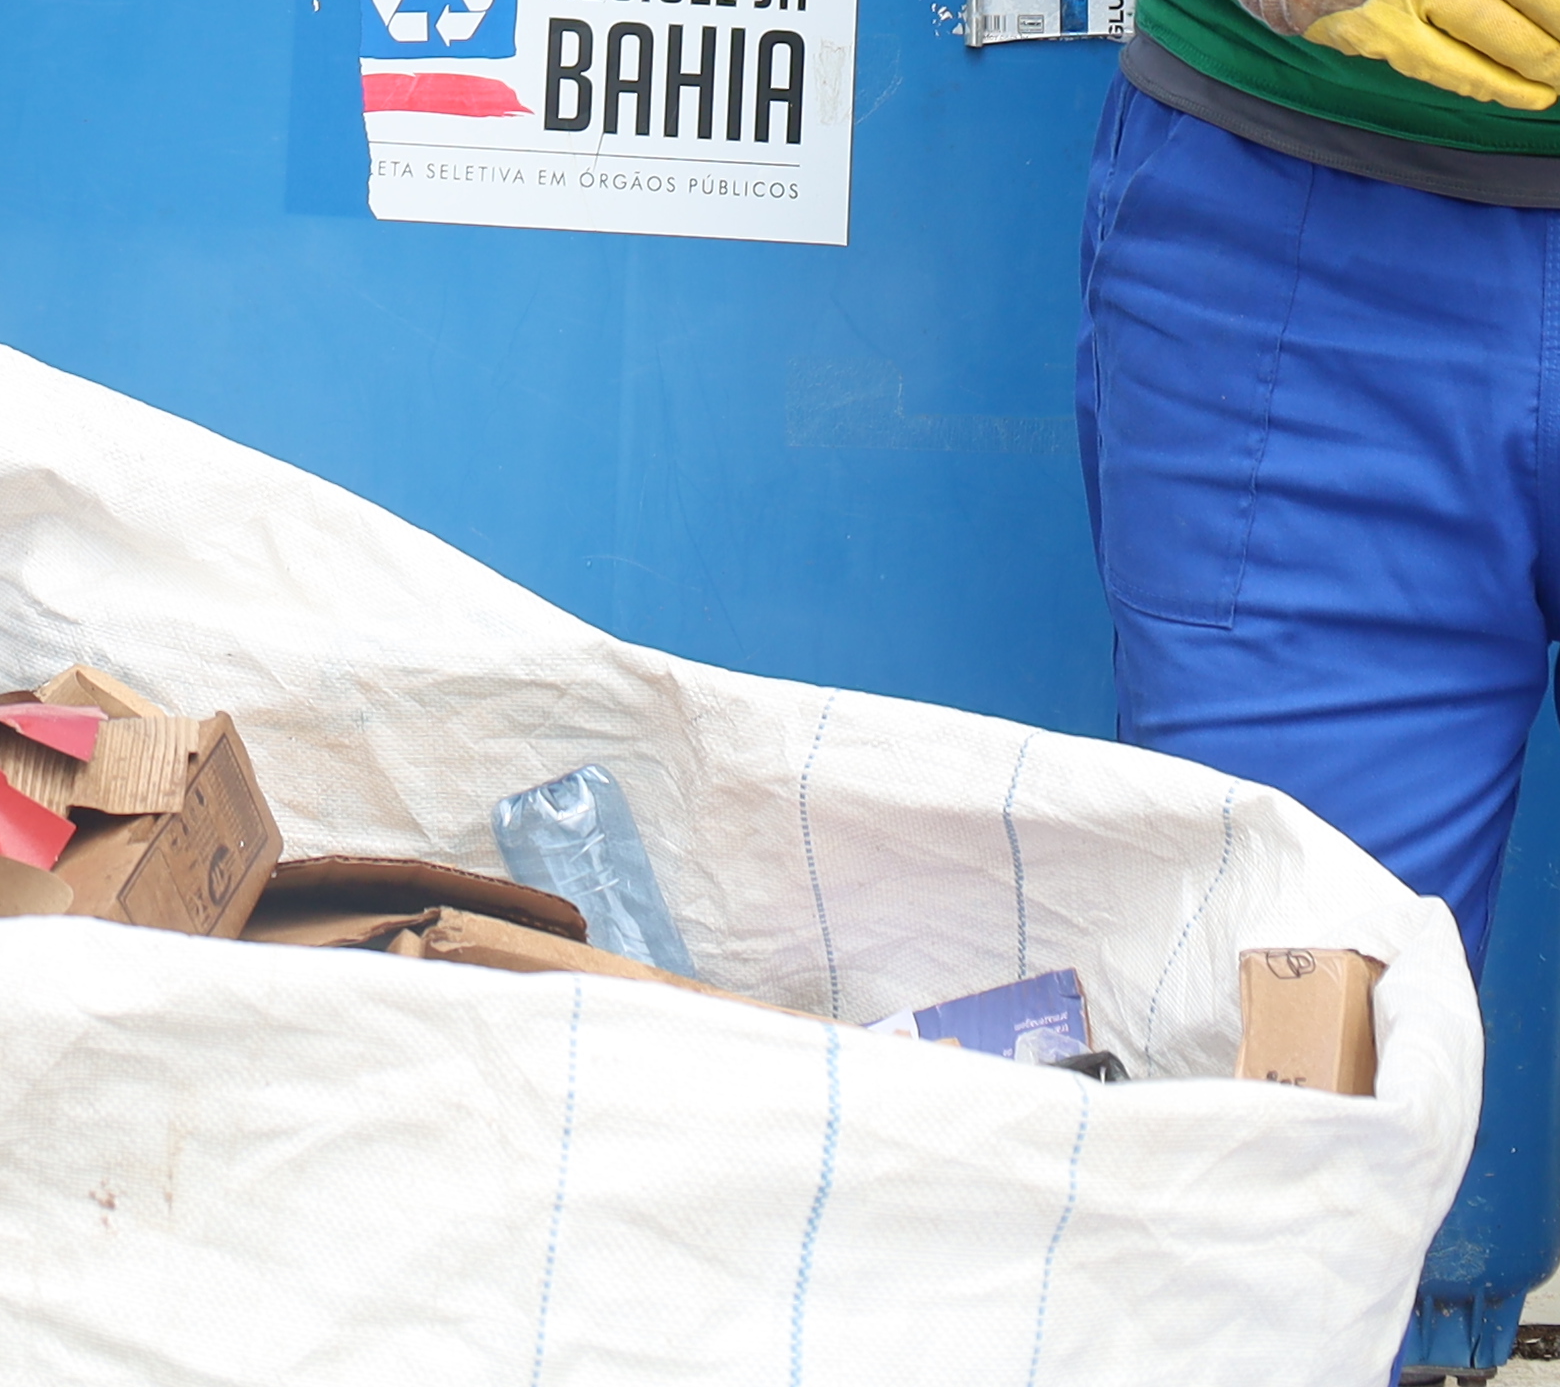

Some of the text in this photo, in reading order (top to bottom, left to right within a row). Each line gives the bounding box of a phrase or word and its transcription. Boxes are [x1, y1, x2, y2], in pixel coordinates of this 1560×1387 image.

[543, 16, 806, 145] BAHIA
[370, 160, 800, 200] ETA SELETIVA EM ÓRGÃOS PÚBLICOS
